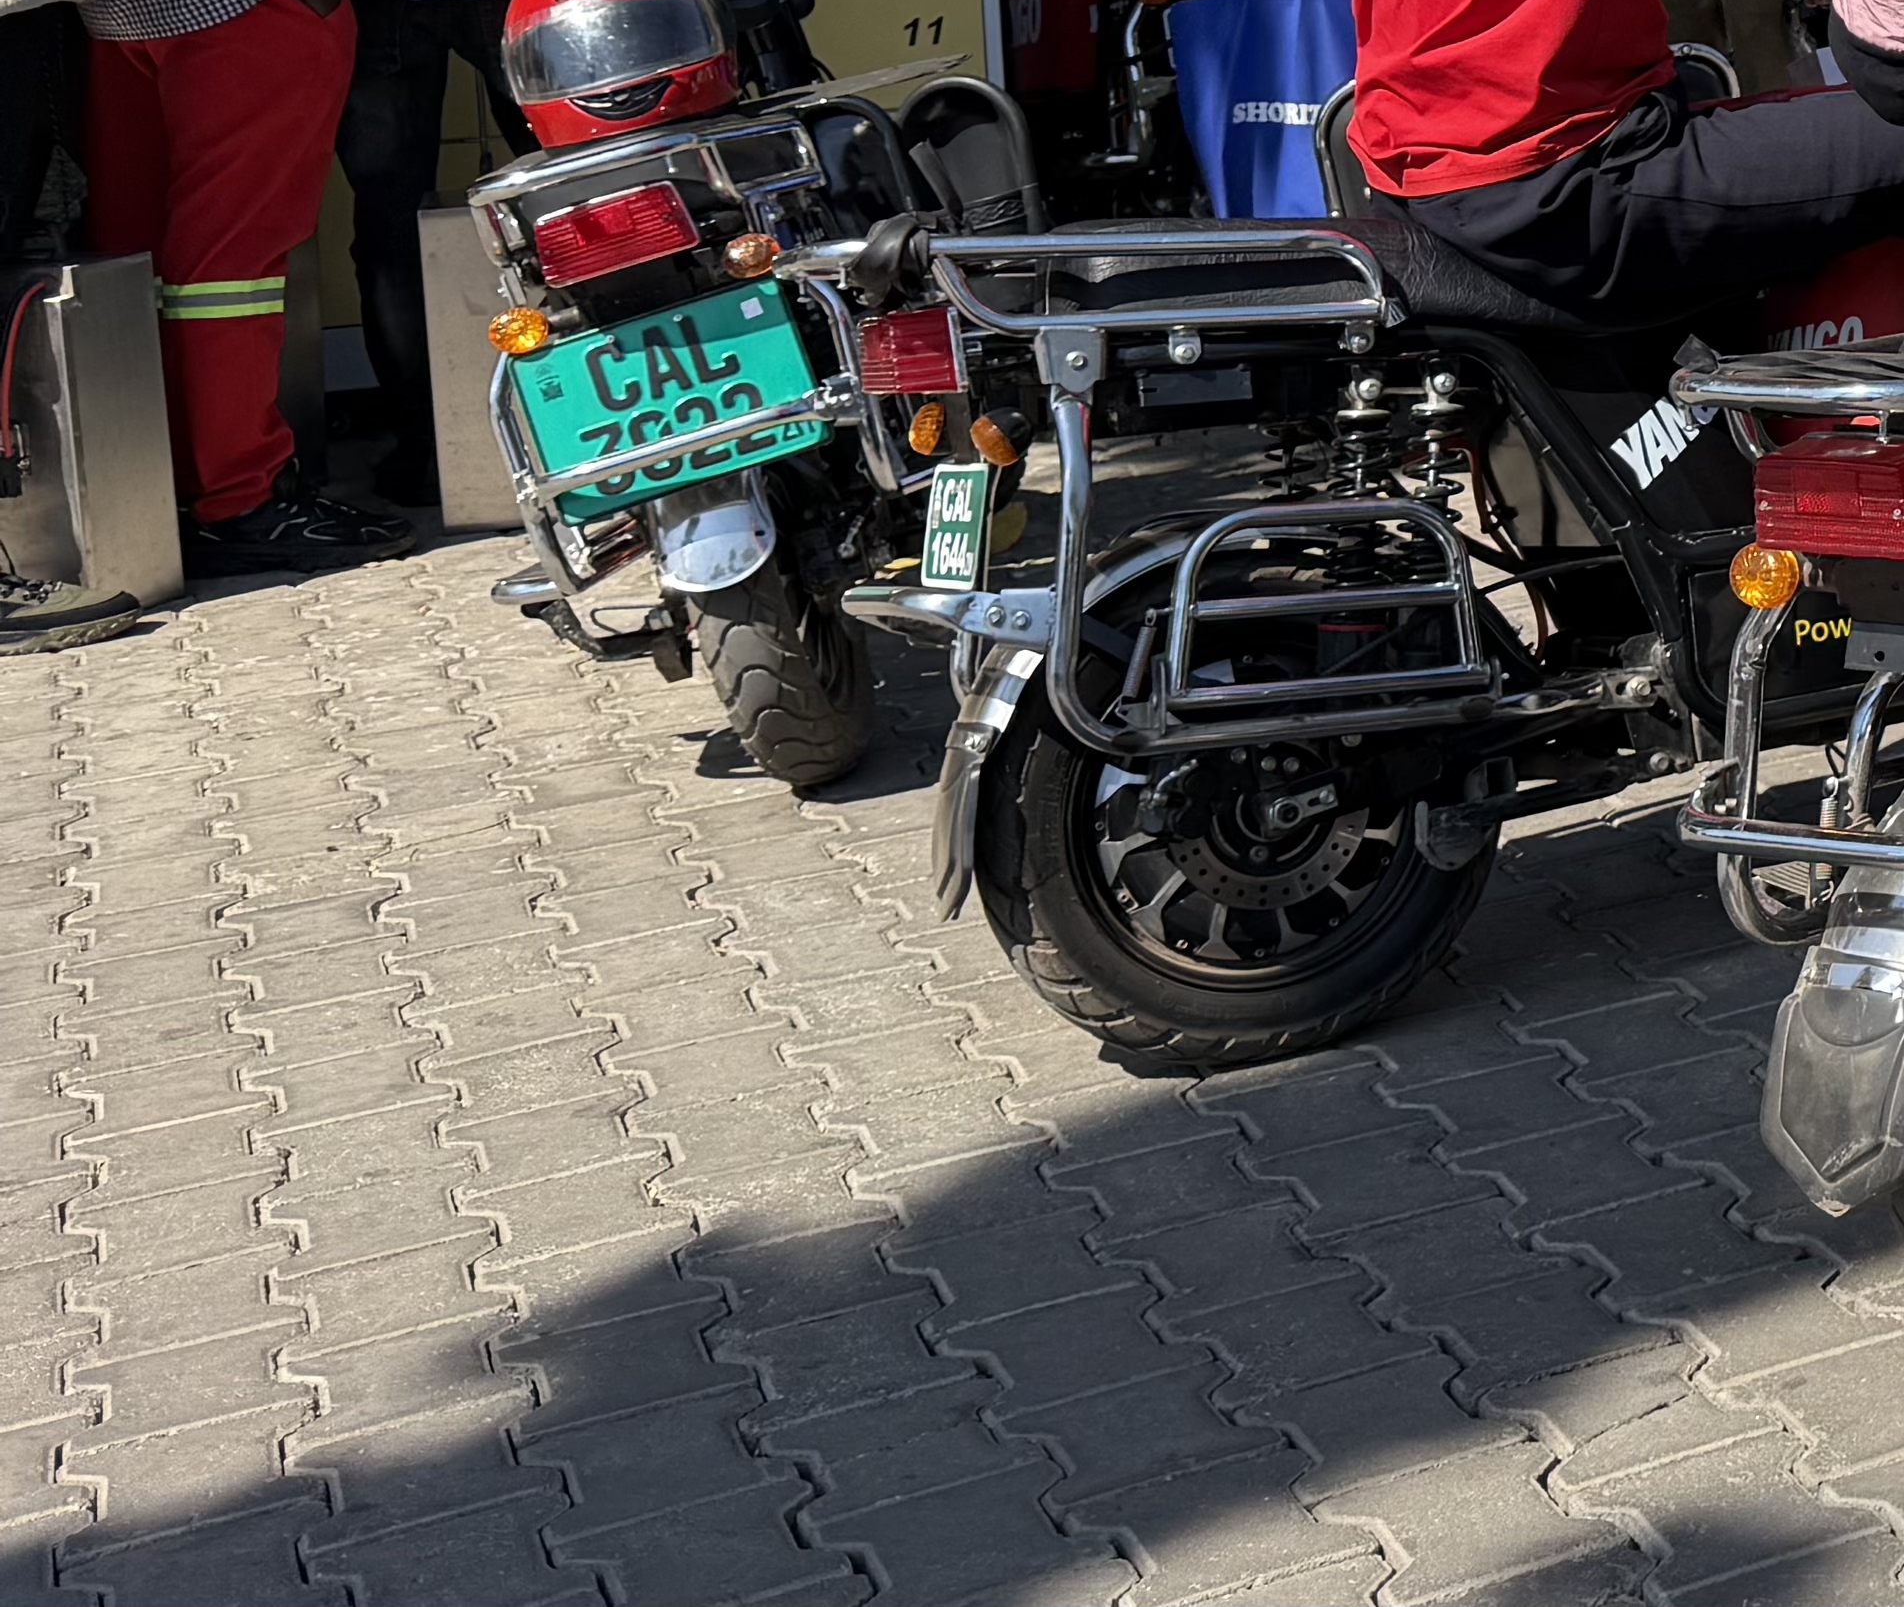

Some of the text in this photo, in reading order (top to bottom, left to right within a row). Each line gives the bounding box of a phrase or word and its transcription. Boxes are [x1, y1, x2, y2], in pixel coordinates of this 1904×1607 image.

[903, 16, 944, 46] 11
[585, 314, 741, 412] CAL
[941, 478, 973, 522] CAL
